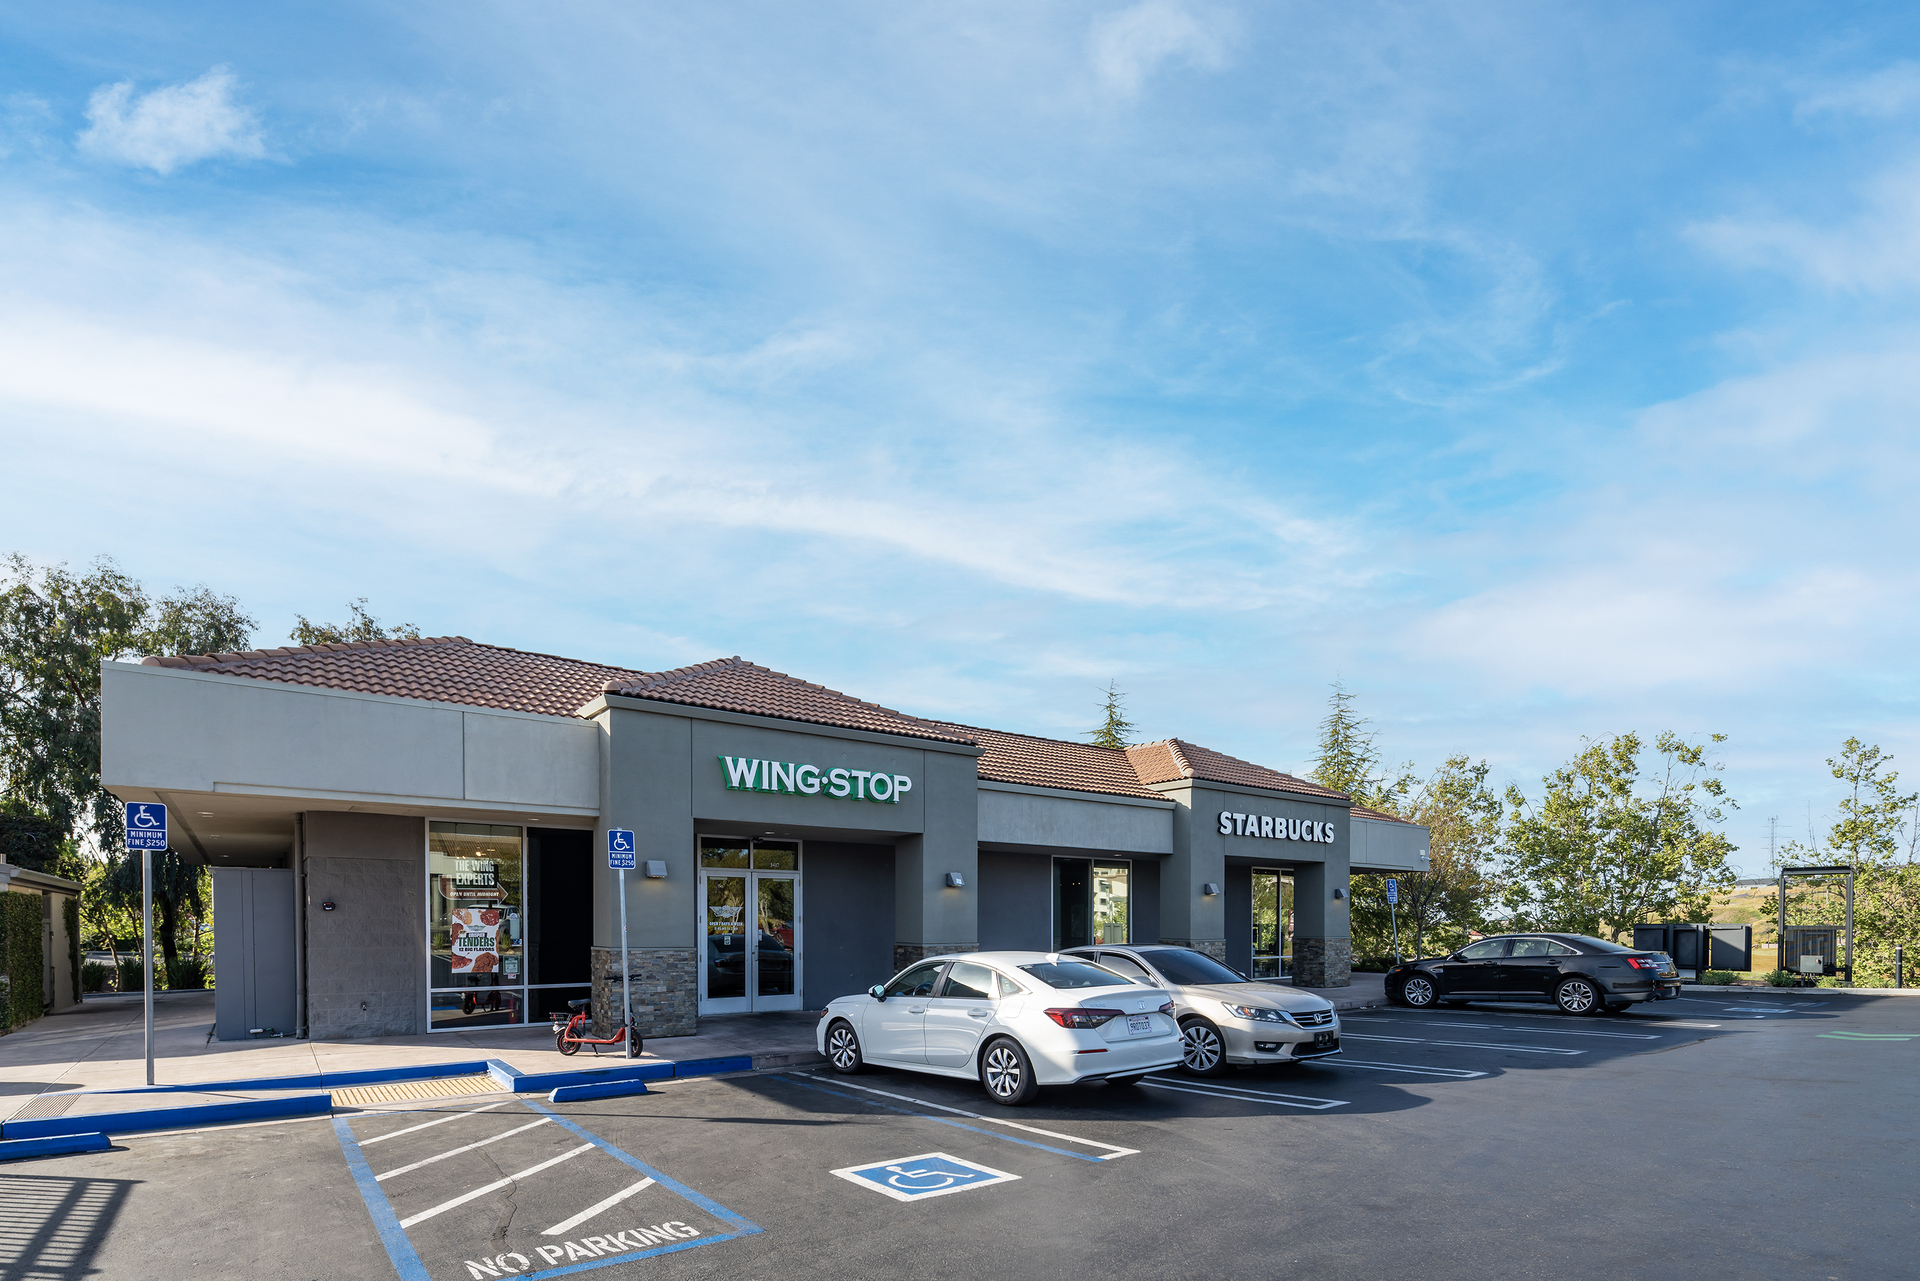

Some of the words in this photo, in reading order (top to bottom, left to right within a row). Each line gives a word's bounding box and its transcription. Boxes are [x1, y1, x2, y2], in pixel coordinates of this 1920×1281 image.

[1218, 811, 1335, 844] STARBUCKS
[130, 830, 163, 839] MINIMUM
[127, 838, 144, 846] FINE
[145, 839, 166, 847] $250
[454, 860, 470, 871] THE
[471, 860, 495, 872] WING
[456, 872, 495, 886] EXPERTS
[458, 937, 495, 947] TENDERS
[463, 1252, 531, 1281] NO
[534, 1221, 702, 1266] PARKING
